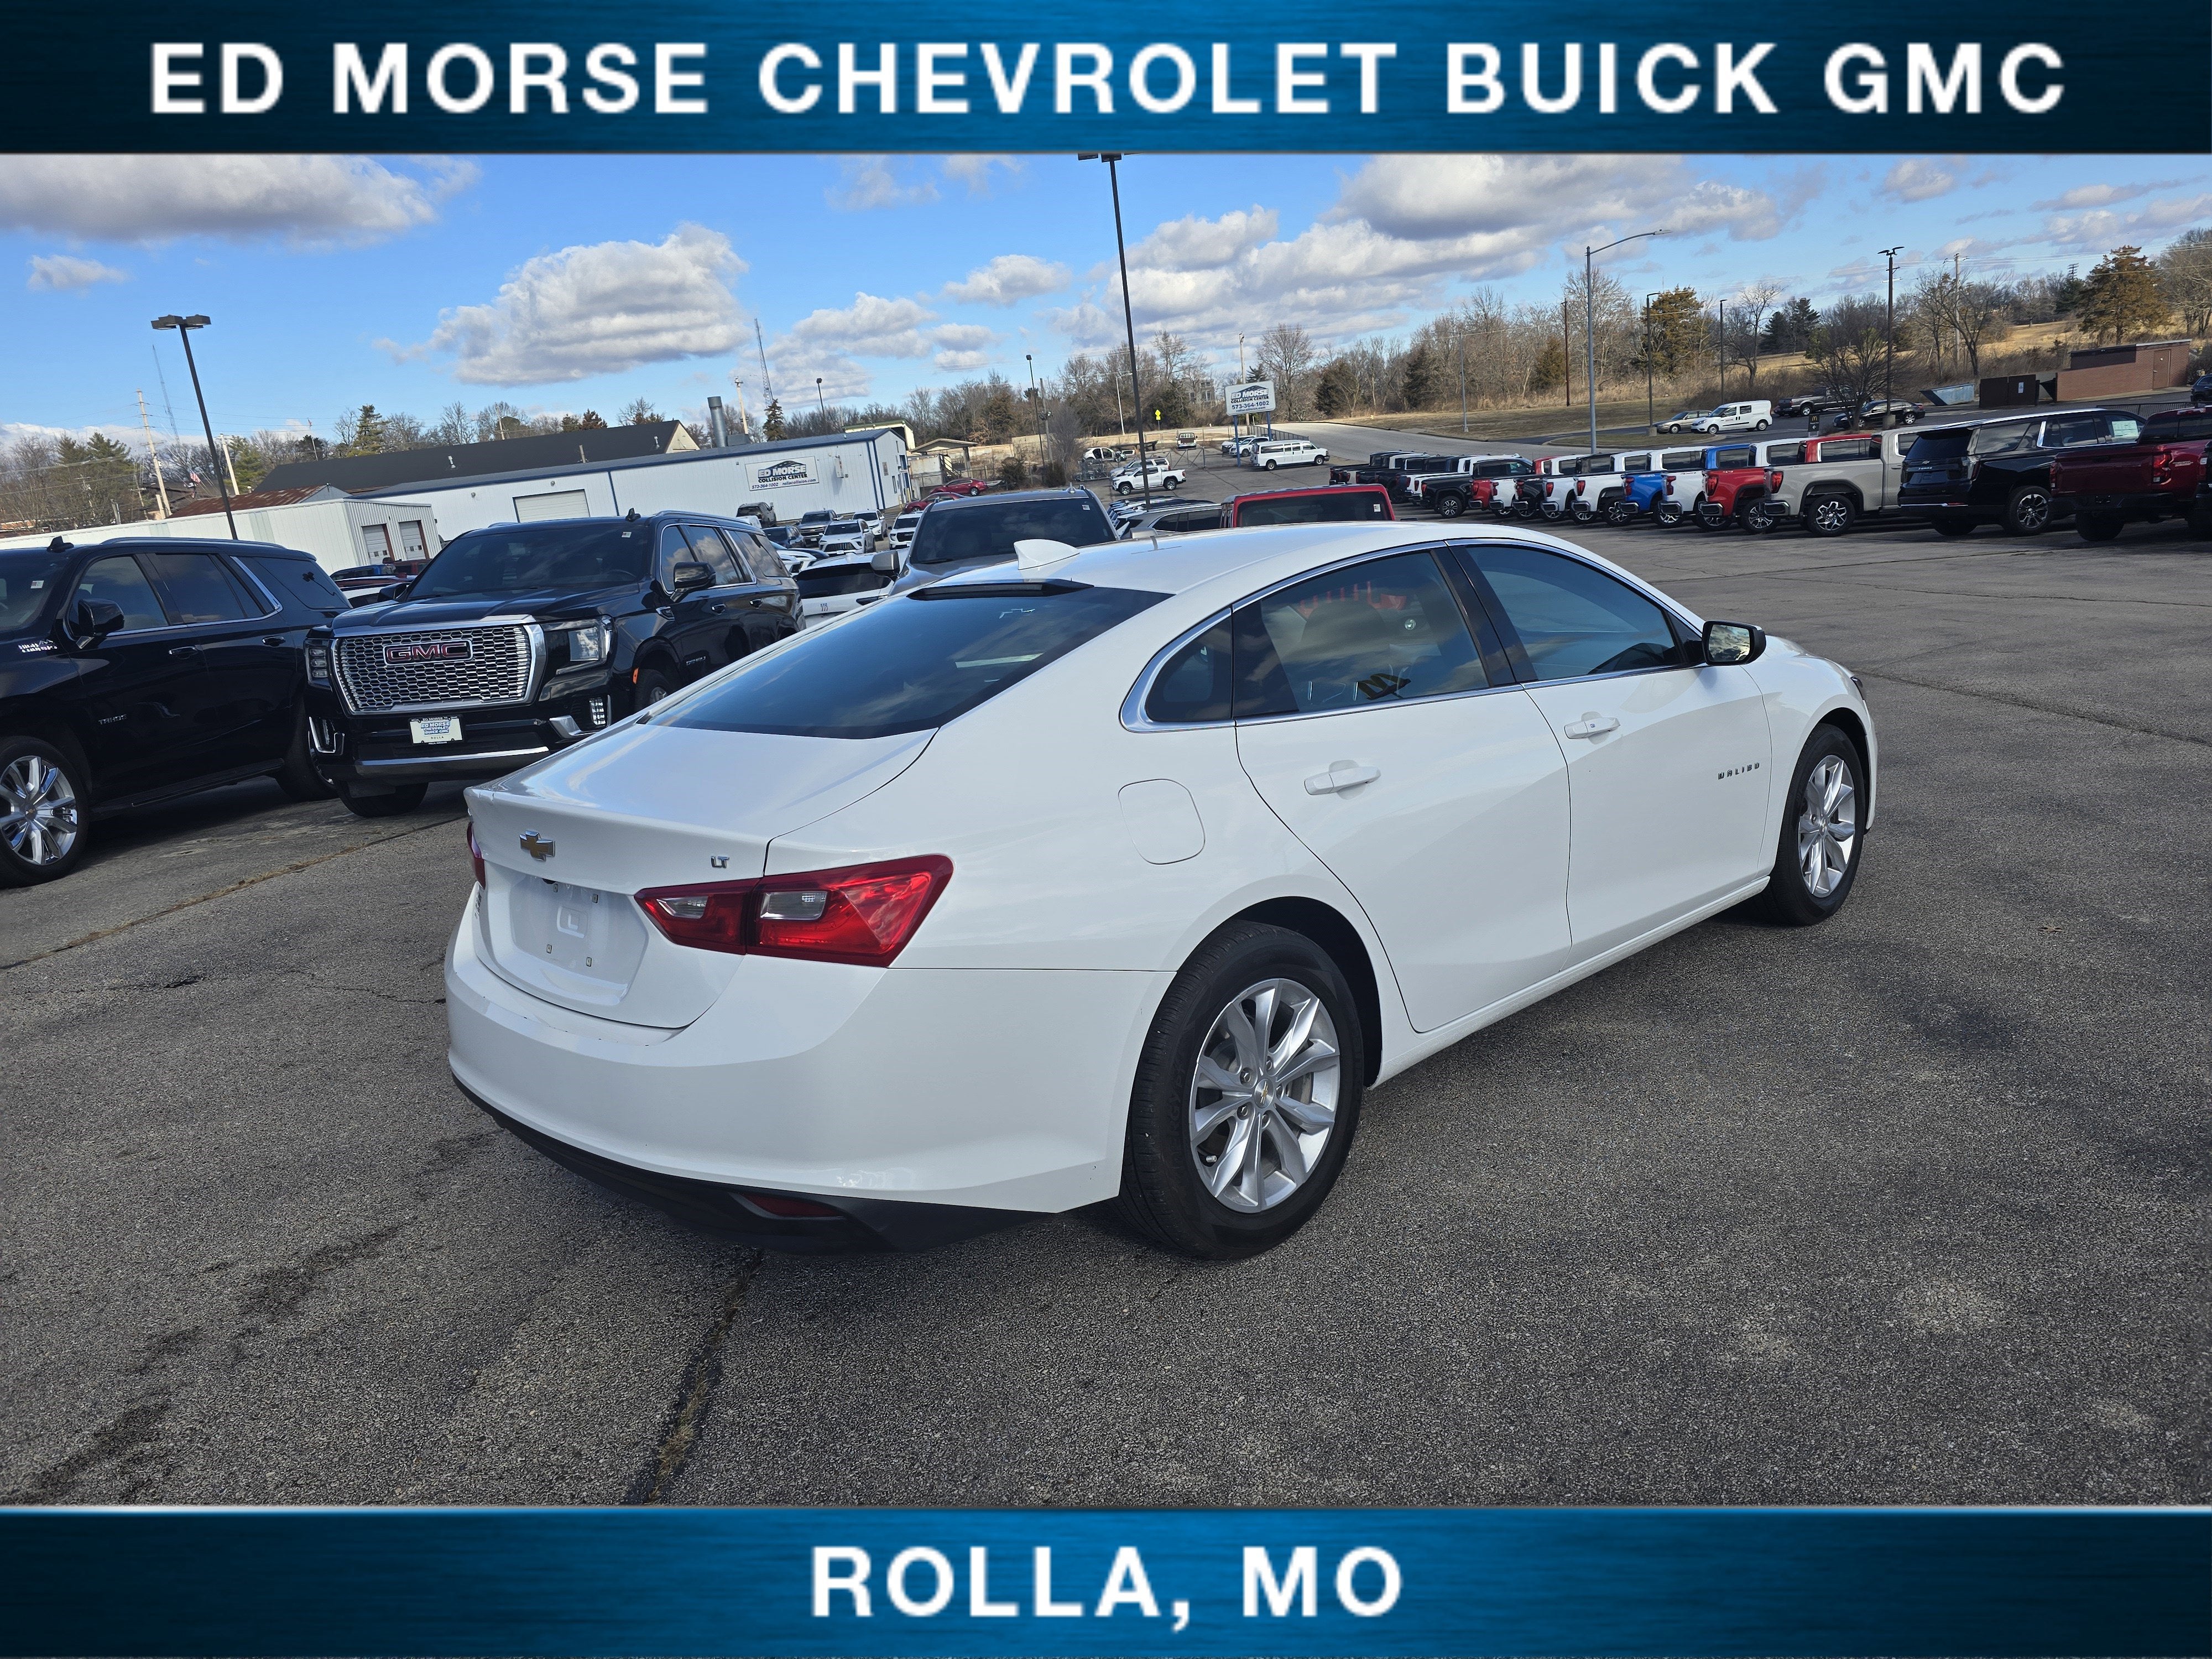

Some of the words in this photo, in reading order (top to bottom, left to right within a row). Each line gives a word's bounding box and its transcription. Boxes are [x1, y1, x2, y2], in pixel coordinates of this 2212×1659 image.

[1242, 389, 1269, 398] MORSE
[758, 469, 771, 478] ED
[772, 465, 806, 476] MORSE
[387, 642, 468, 662] GMC
[1718, 762, 1760, 780] MALIBU
[710, 855, 730, 869] LT
